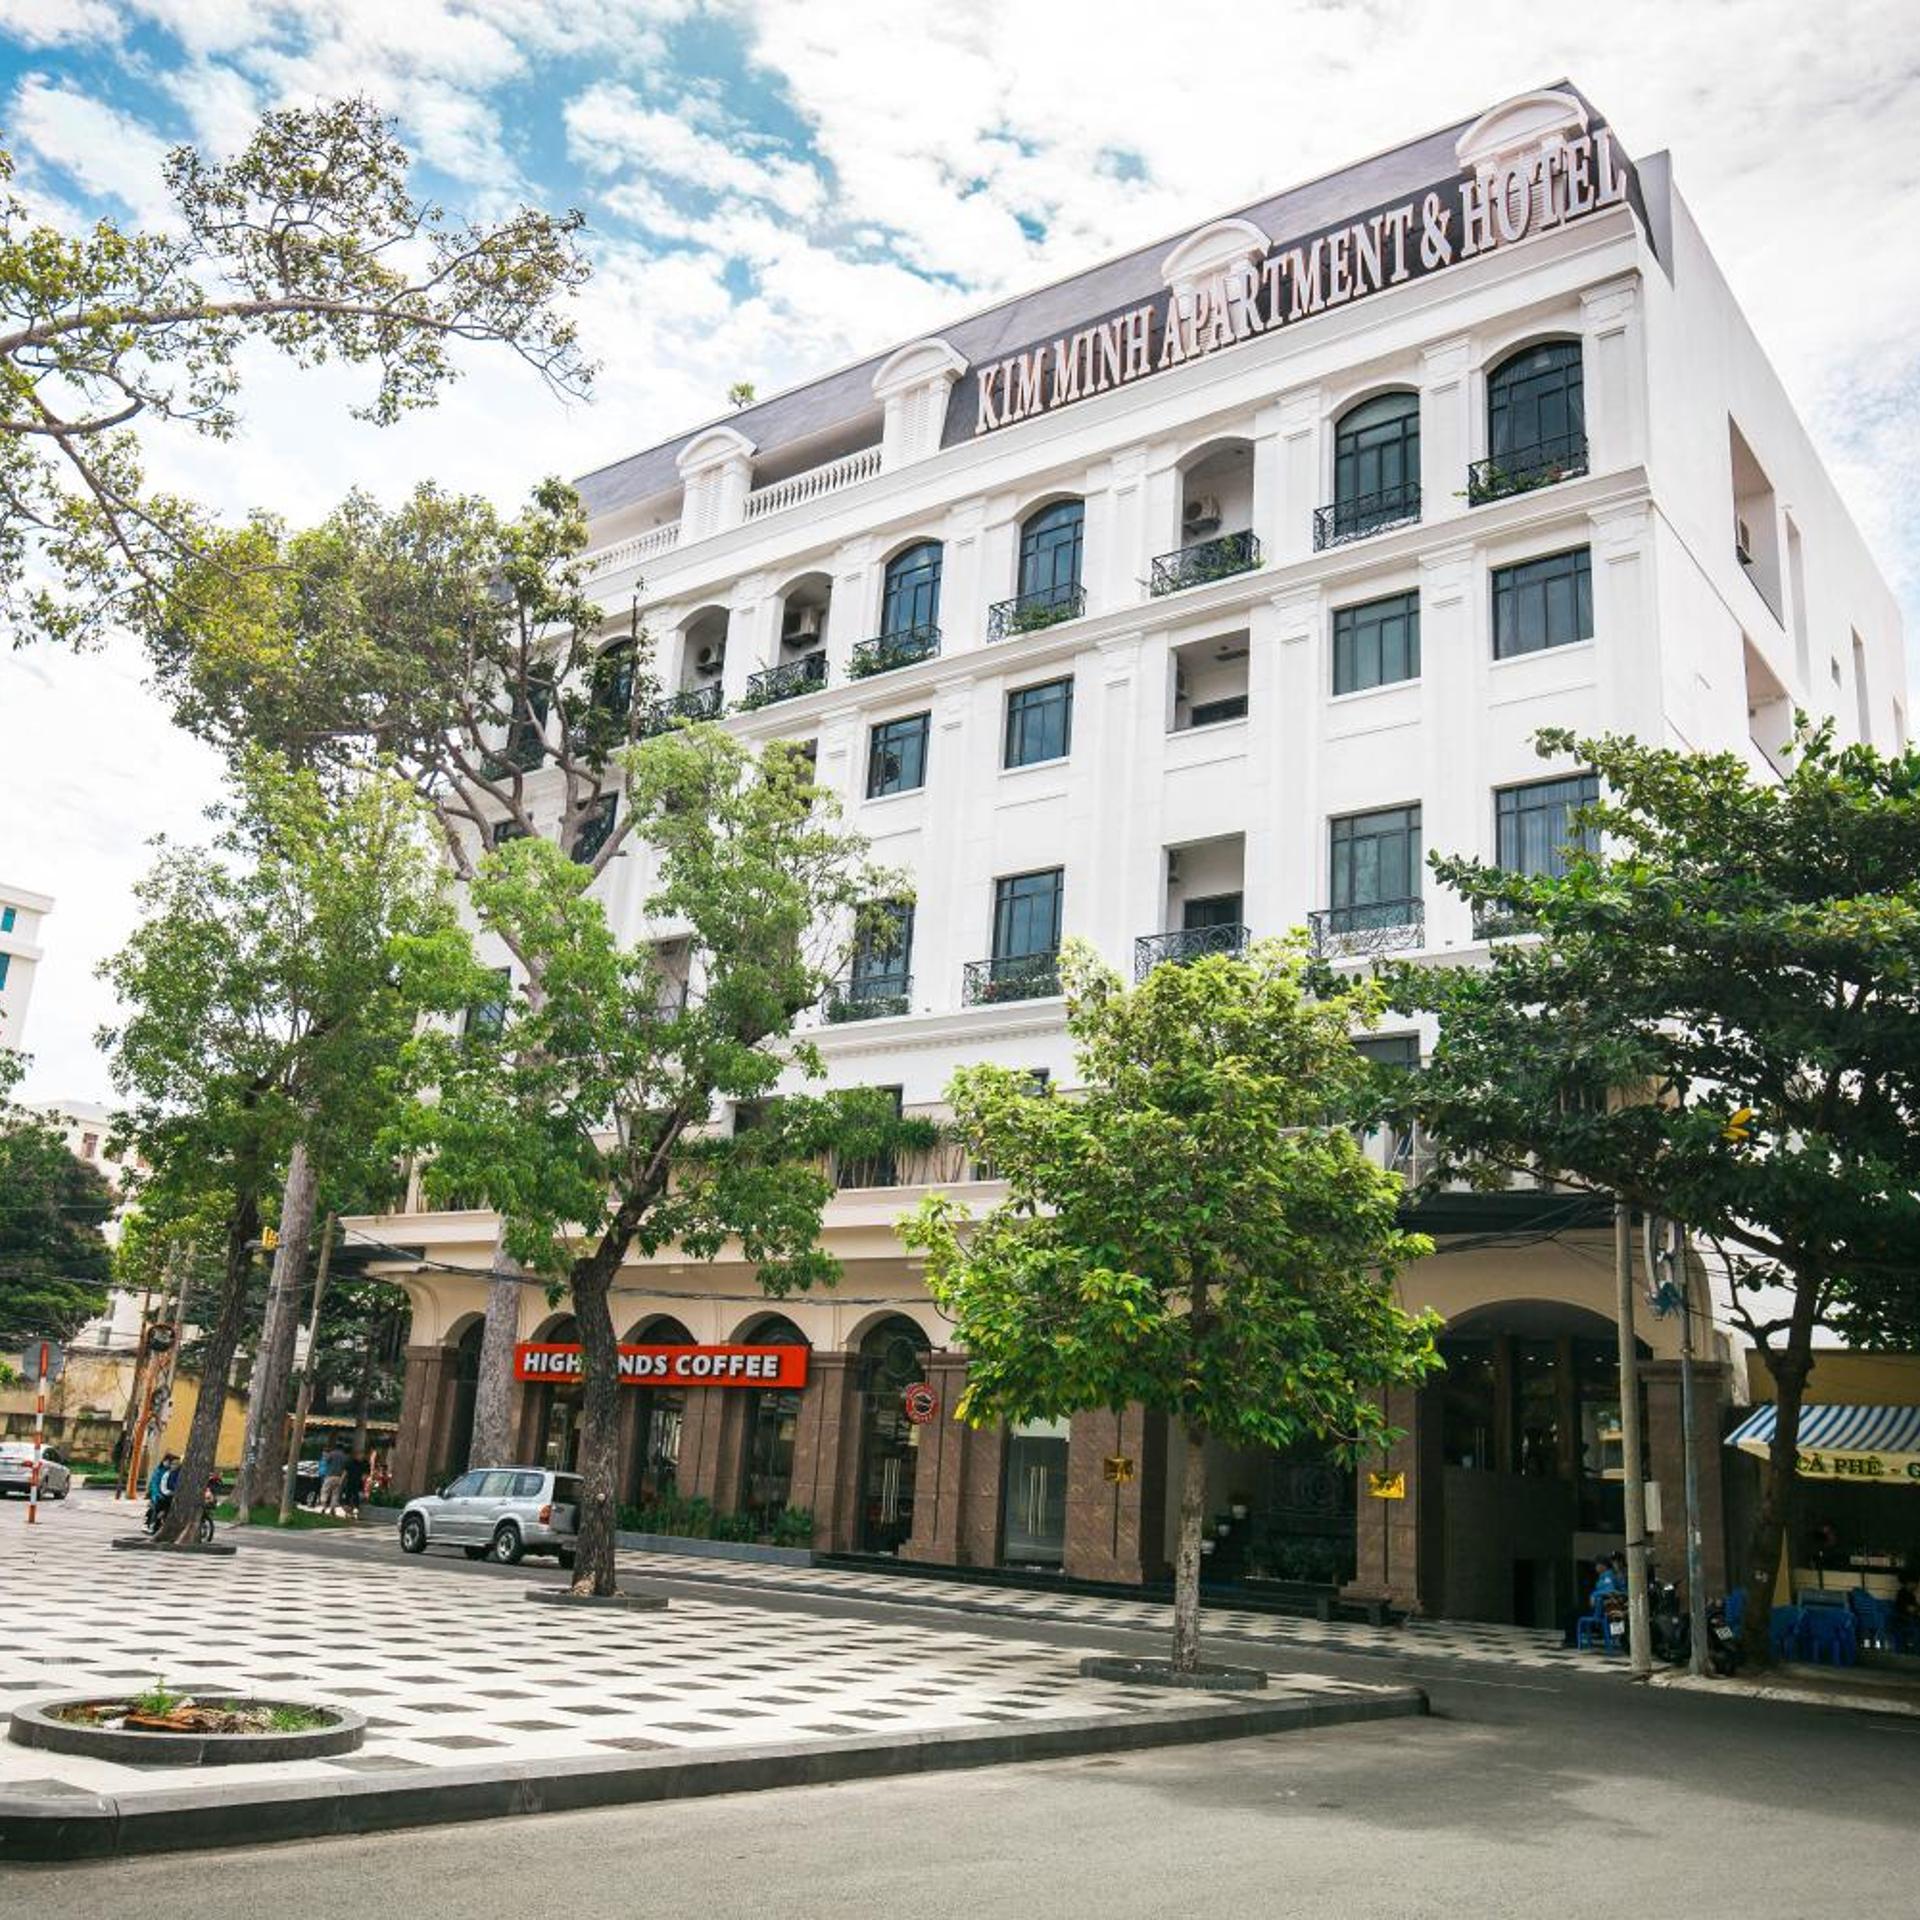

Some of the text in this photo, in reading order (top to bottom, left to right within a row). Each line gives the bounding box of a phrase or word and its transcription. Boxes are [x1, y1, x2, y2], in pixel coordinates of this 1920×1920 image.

[975, 125, 1628, 434] KIM MINH APARTMENT & HOTEL
[524, 1352, 778, 1378] HIGHNDS COFFEE
[1834, 1455, 1883, 1476] PHÊ
